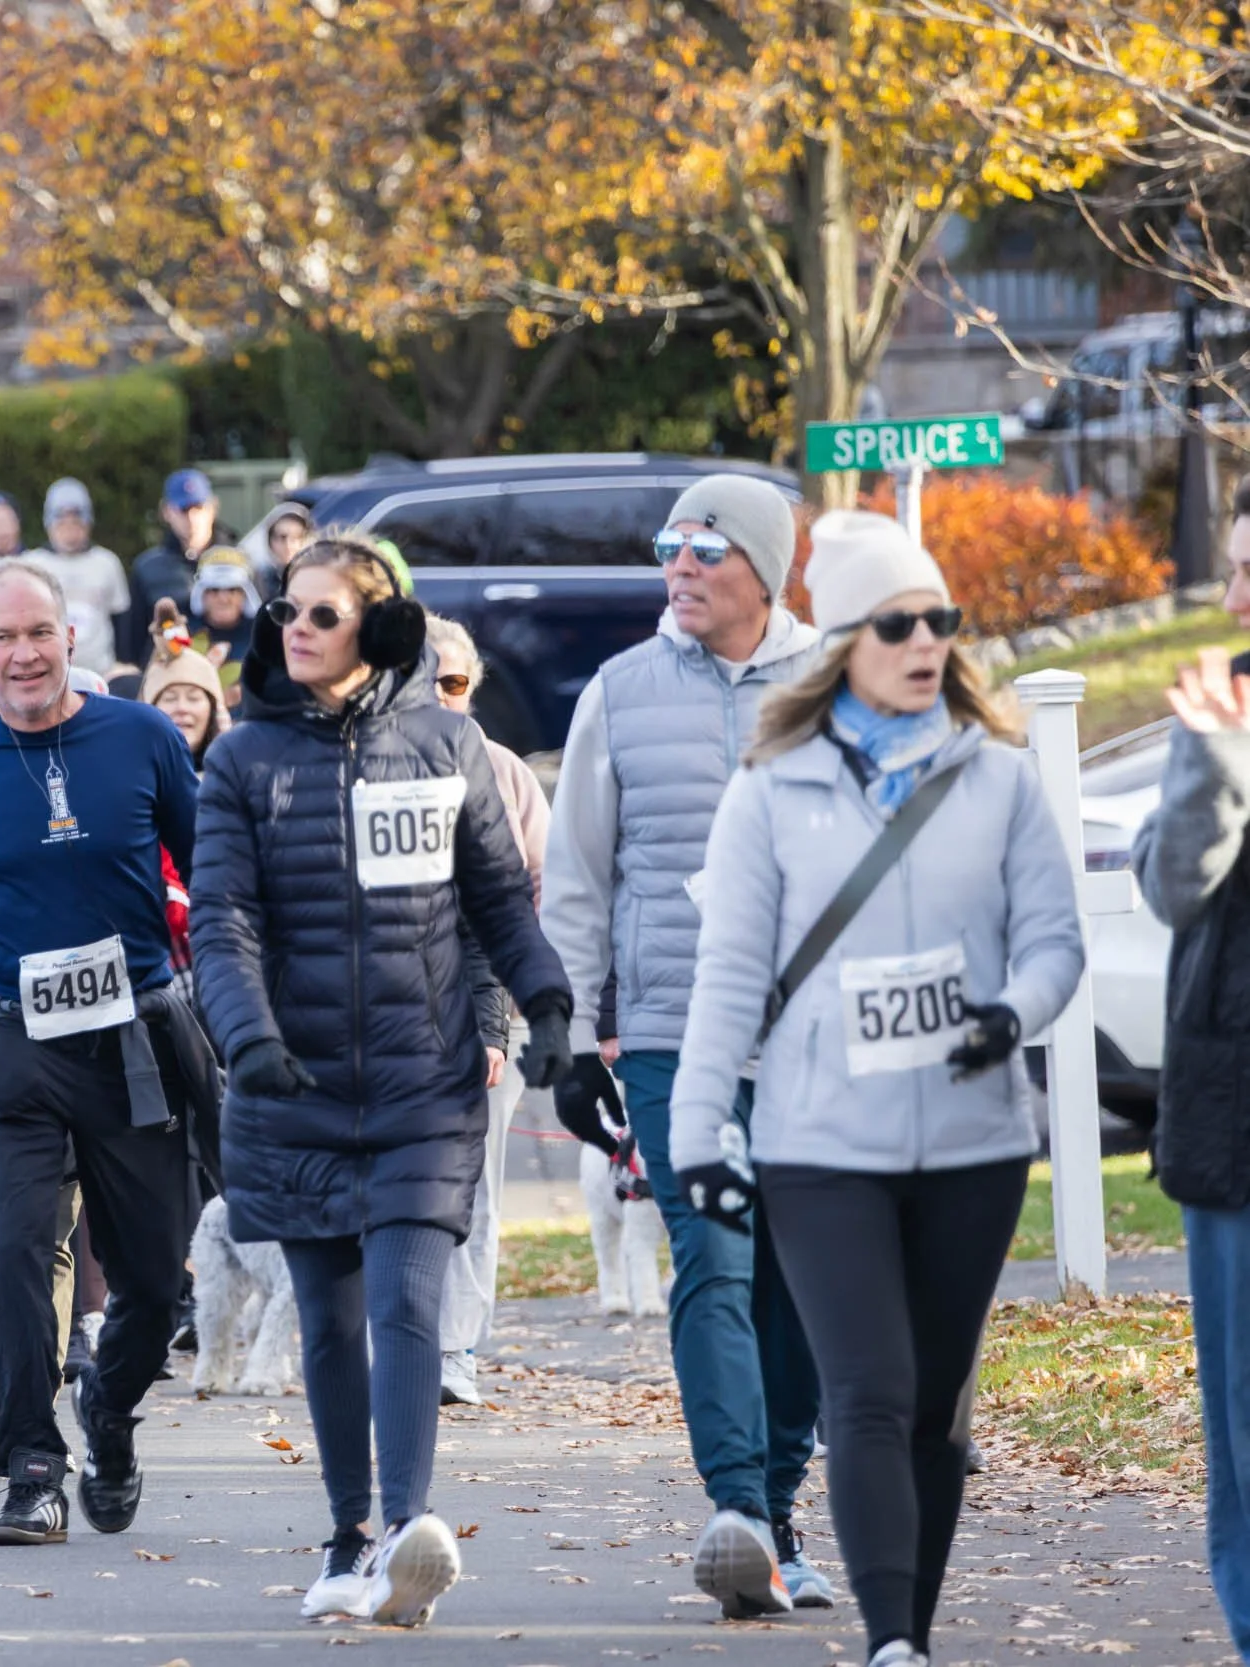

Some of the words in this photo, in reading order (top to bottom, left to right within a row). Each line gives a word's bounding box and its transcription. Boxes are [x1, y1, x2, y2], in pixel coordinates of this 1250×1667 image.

[832, 423, 968, 467] SPRUCE
[32, 961, 121, 1014] 5494
[858, 975, 965, 1041] 5206
